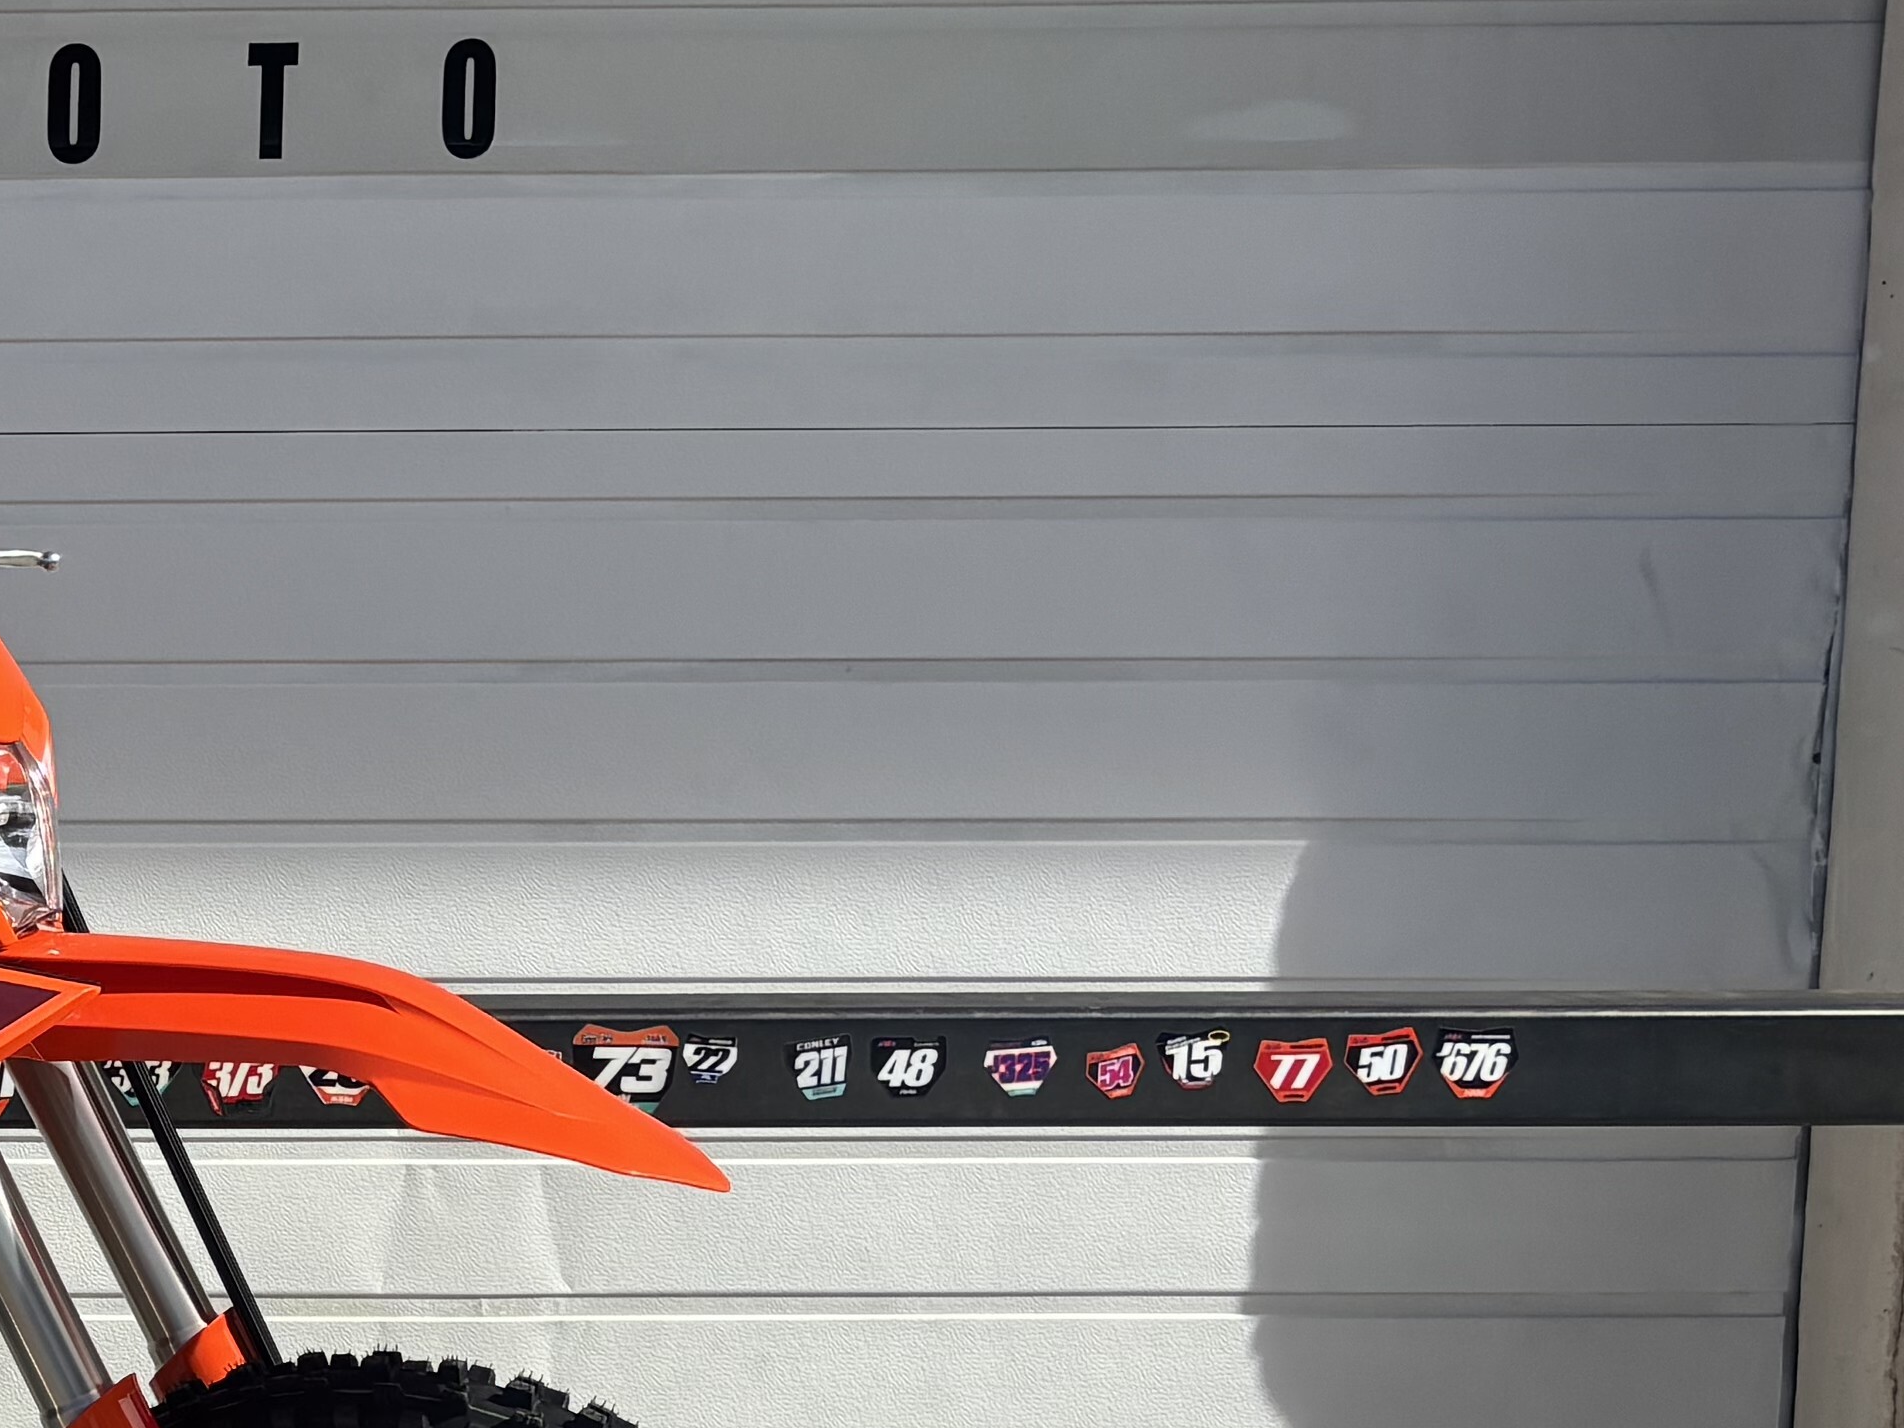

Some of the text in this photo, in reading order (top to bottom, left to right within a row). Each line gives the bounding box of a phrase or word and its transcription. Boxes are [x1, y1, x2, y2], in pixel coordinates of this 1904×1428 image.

[689, 1046, 732, 1074] 22
[796, 1037, 840, 1051] CONLEY
[1165, 1039, 1225, 1082] 15
[1357, 1044, 1408, 1083] 50
[592, 1046, 672, 1093] 73
[794, 1045, 848, 1088] 211
[877, 1048, 938, 1088] 48
[1097, 1055, 1134, 1090] 54
[1270, 1053, 1321, 1090] 77
